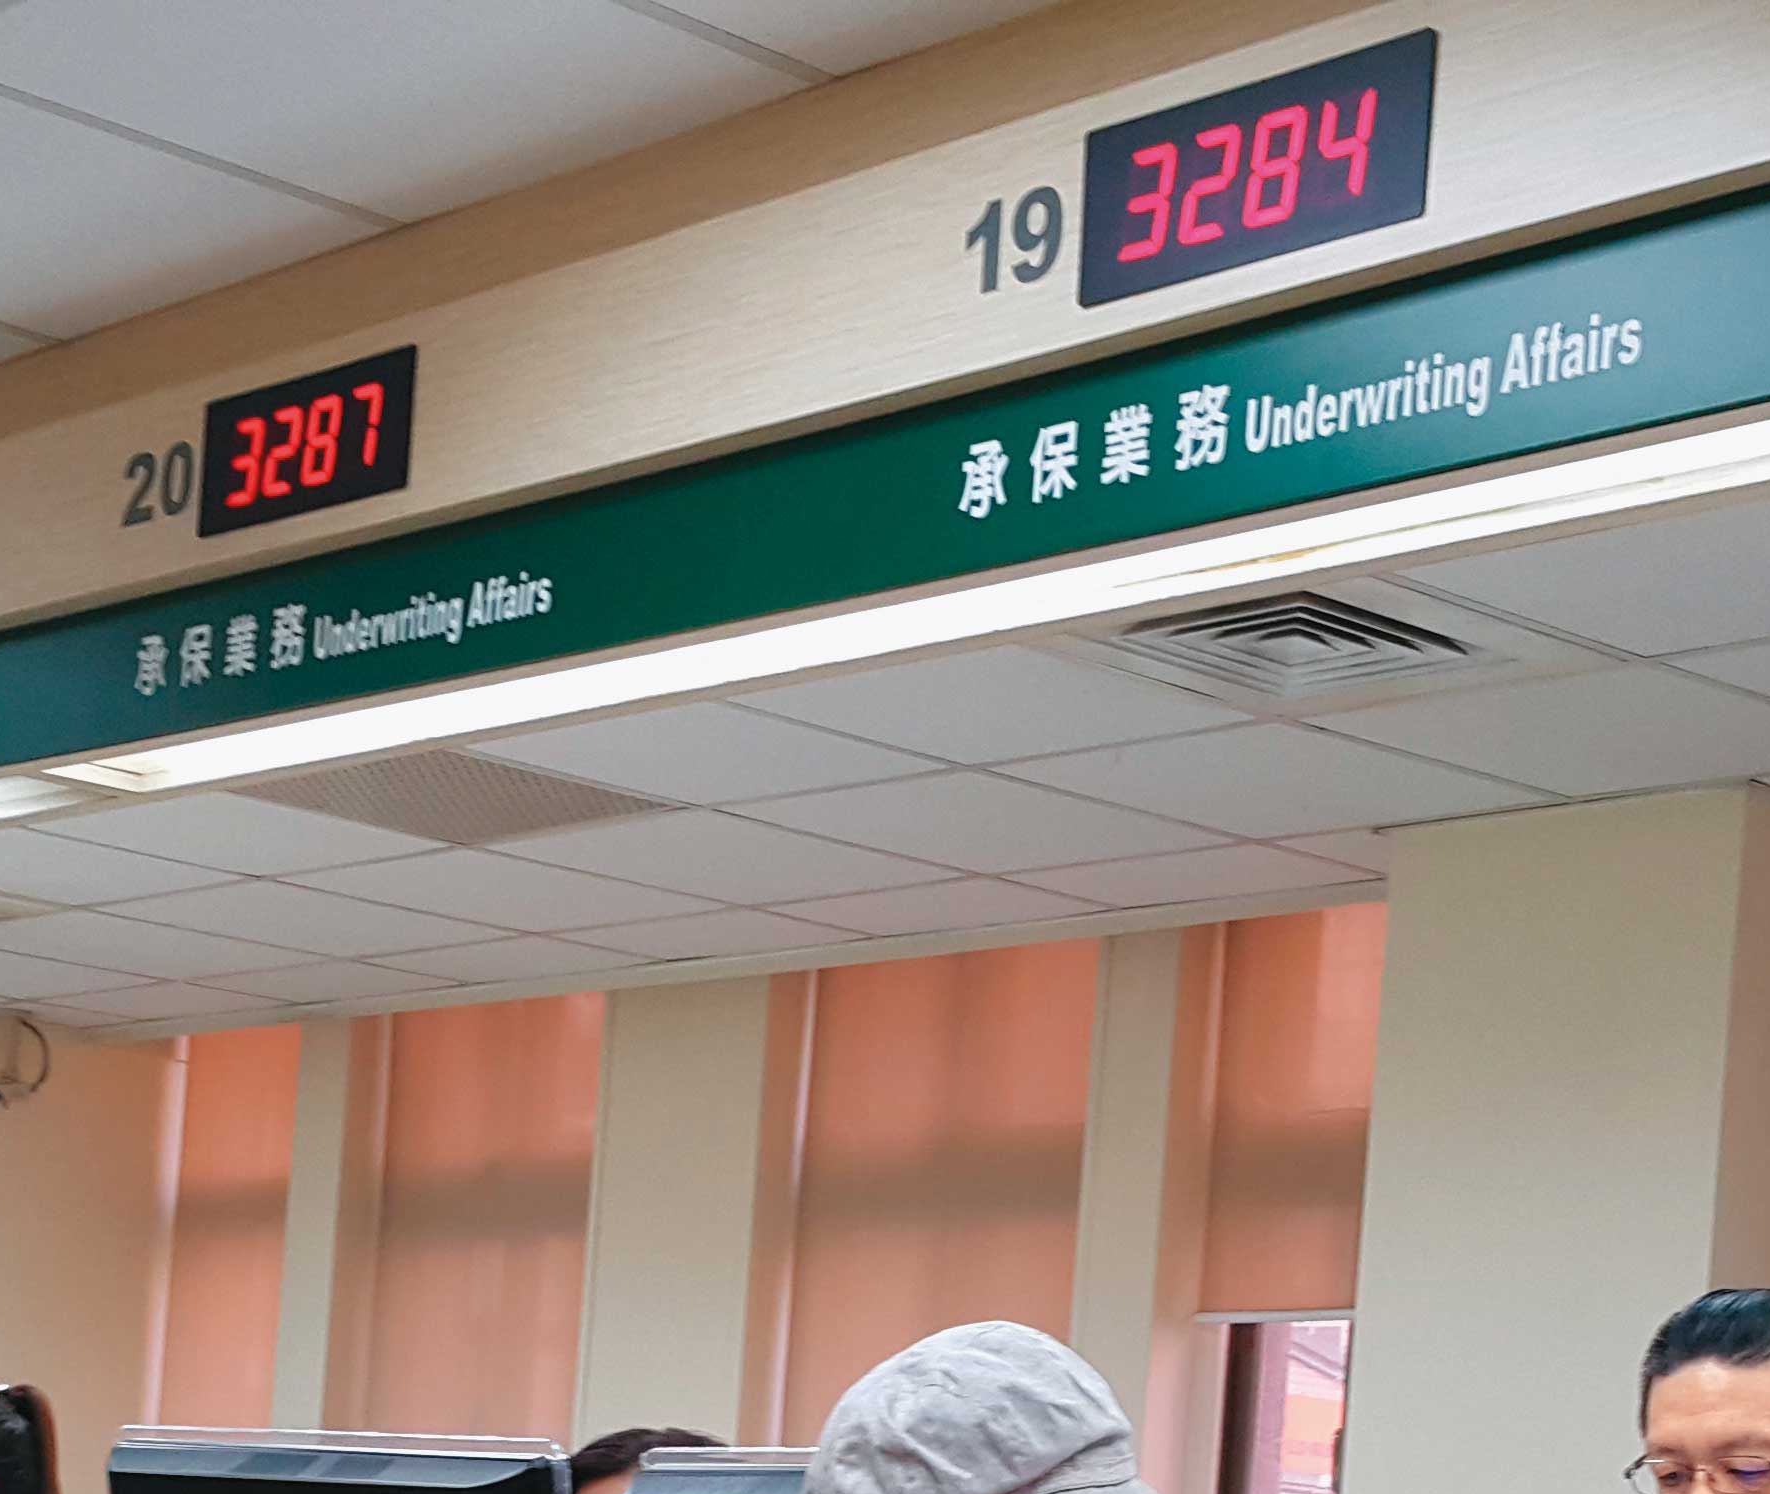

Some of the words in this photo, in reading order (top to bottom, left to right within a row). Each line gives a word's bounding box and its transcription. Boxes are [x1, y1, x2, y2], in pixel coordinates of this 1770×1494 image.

[1116, 87, 1379, 264] 3284
[965, 185, 1063, 294] 19
[225, 382, 385, 508] 3287
[957, 383, 1231, 519] 承保業務
[1245, 352, 1492, 454] Underwriting
[1500, 313, 1642, 394] Affairs
[121, 440, 194, 527] 20
[137, 603, 307, 696] 承保業務
[313, 591, 465, 644] Underwriting
[466, 570, 554, 628] Affairs
